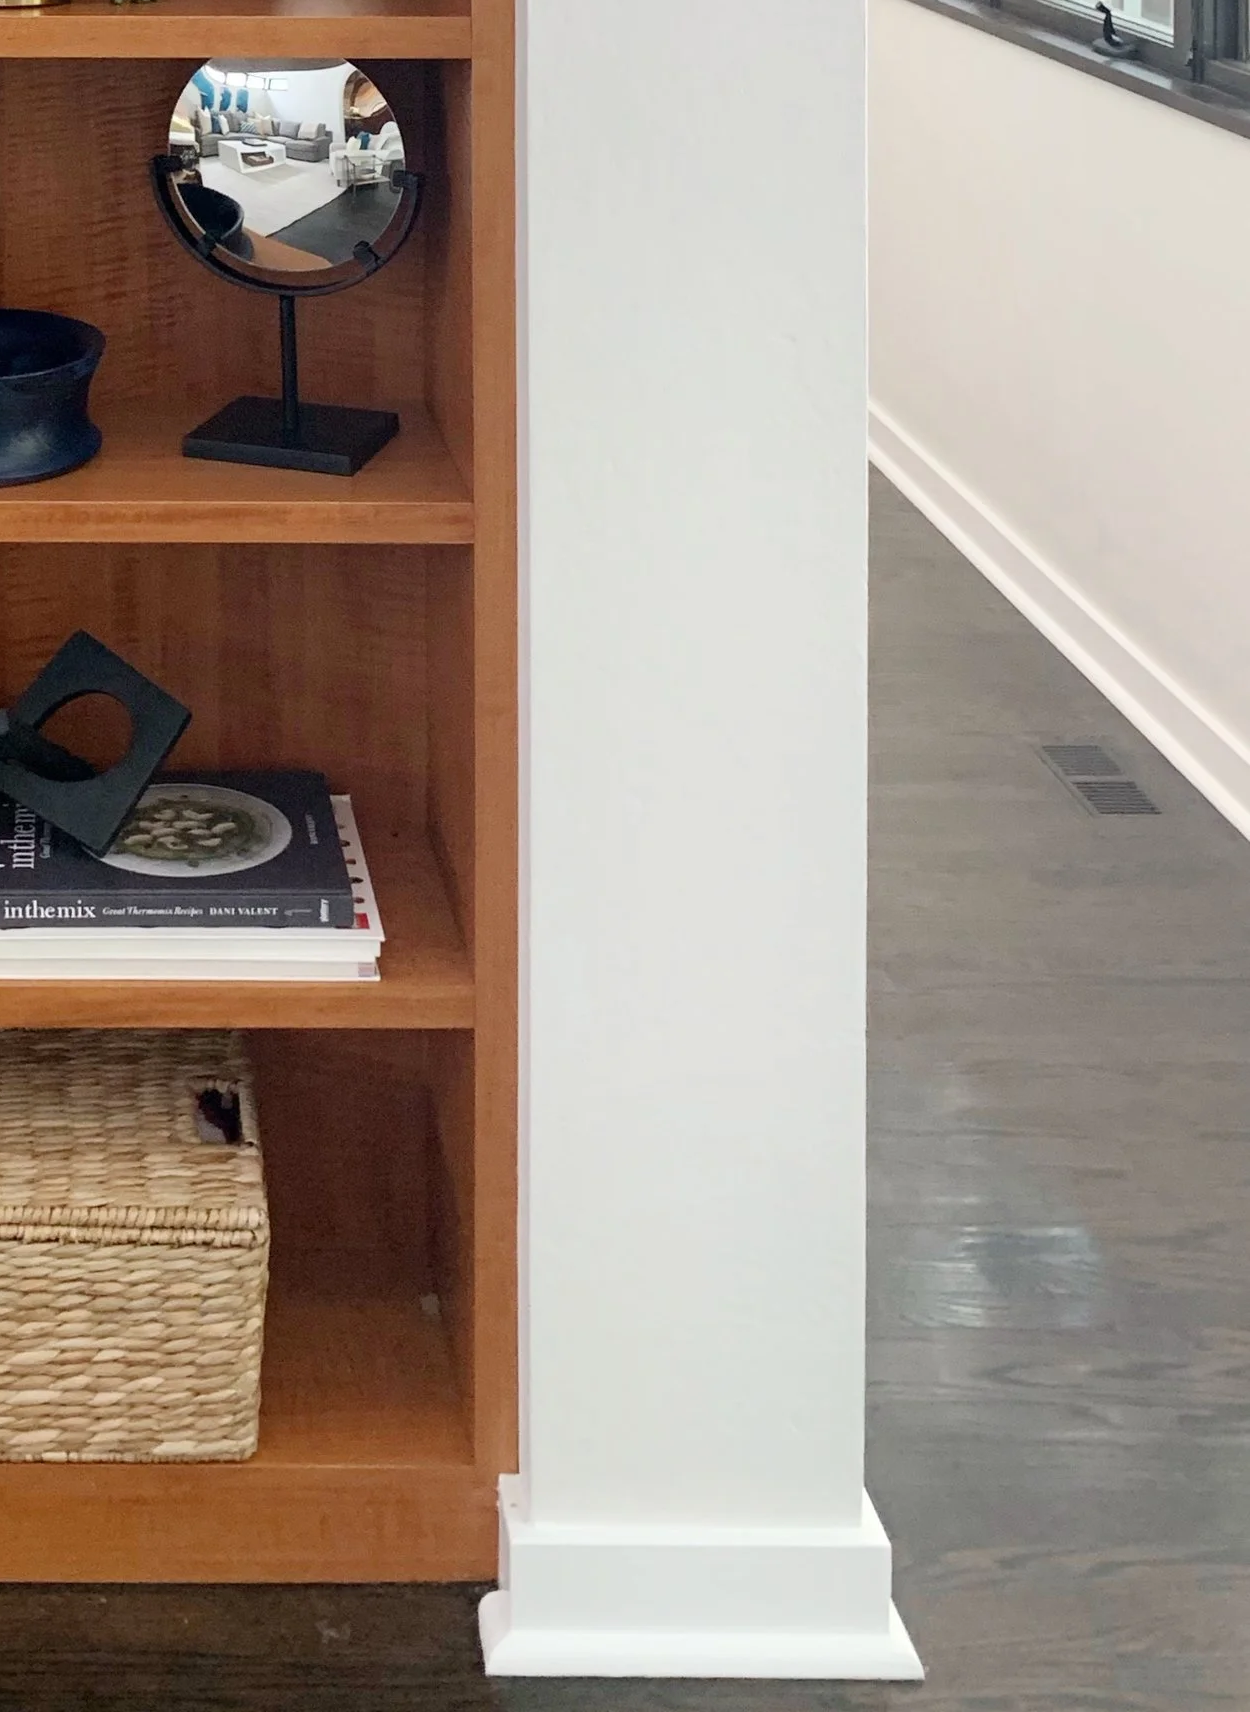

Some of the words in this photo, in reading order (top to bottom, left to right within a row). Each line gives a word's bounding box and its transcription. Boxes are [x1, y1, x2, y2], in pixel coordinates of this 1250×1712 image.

[3, 899, 96, 919] inthemix
[102, 906, 126, 916] Great
[127, 905, 173, 916] Thermomix
[174, 905, 204, 918] Recipes
[209, 906, 235, 916] DANI
[237, 906, 279, 916] VALENT
